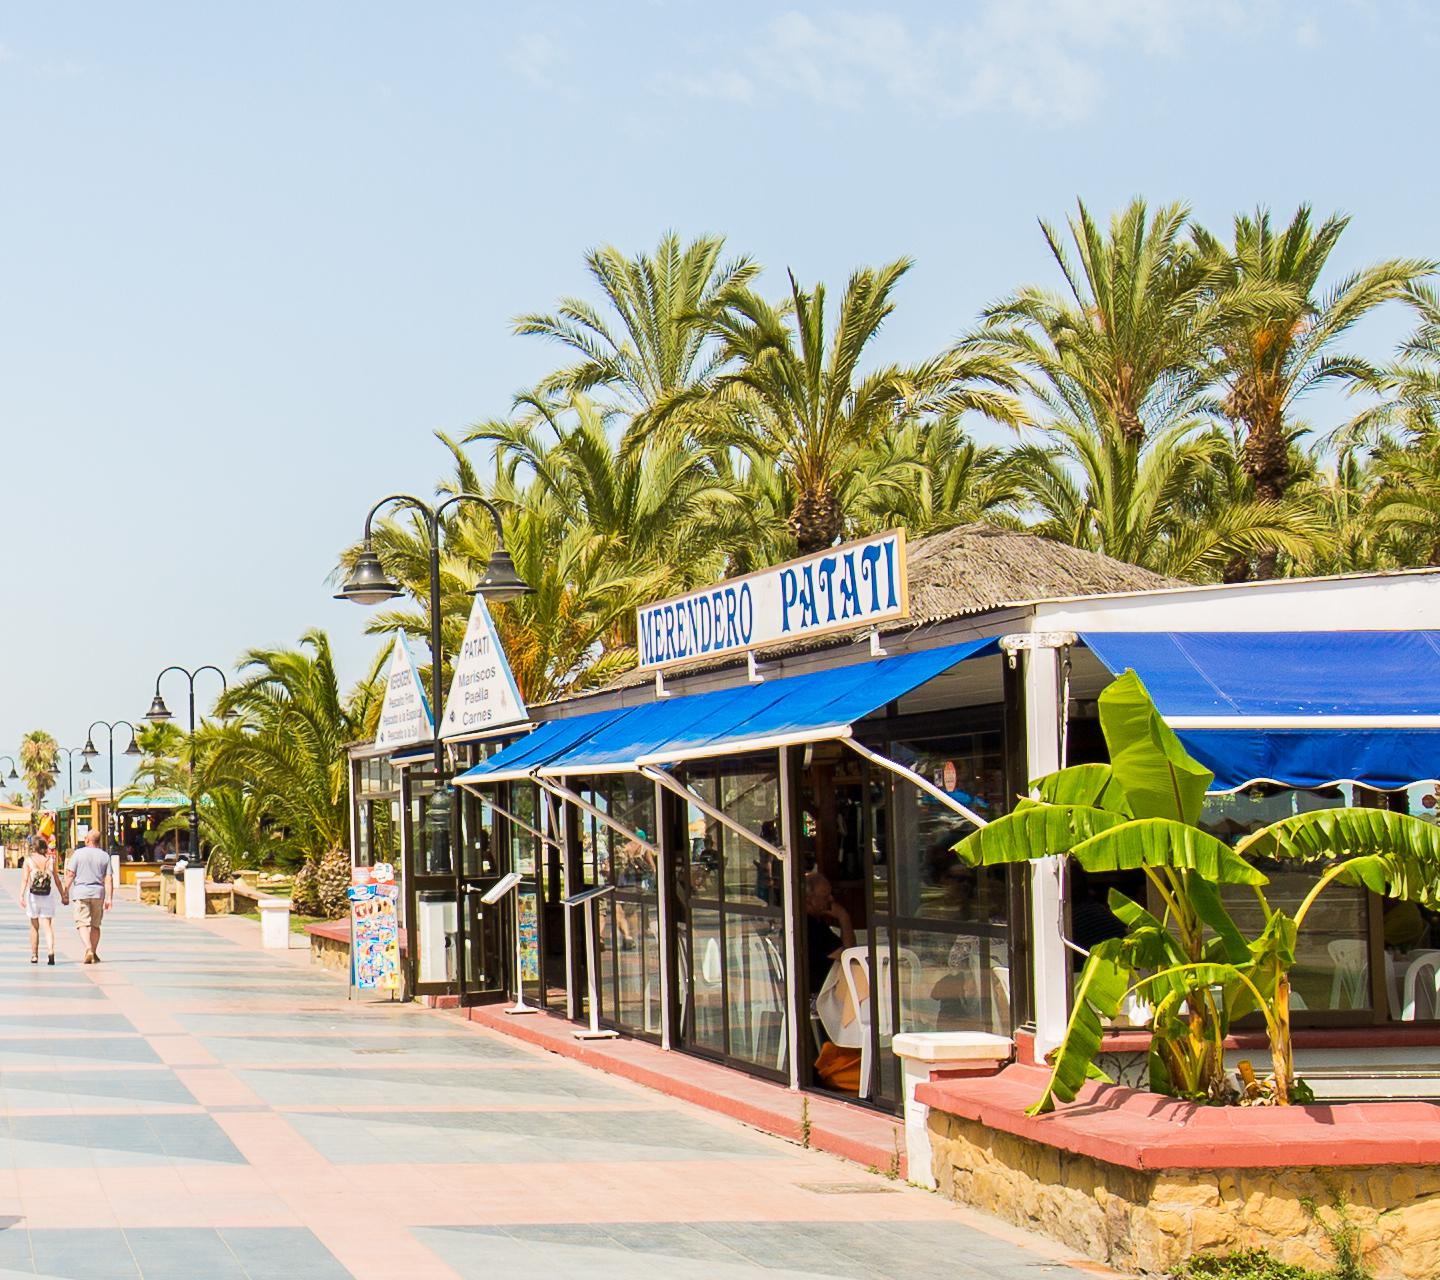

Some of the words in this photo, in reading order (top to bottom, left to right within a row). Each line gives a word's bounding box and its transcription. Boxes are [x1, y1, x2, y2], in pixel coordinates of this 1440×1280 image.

[640, 581, 753, 665] MERENDERO
[779, 538, 898, 632] PATATI
[464, 635, 490, 660] PATATI
[458, 665, 496, 688] Mariscos
[464, 687, 489, 706] Paella
[462, 708, 492, 726] Carnes
